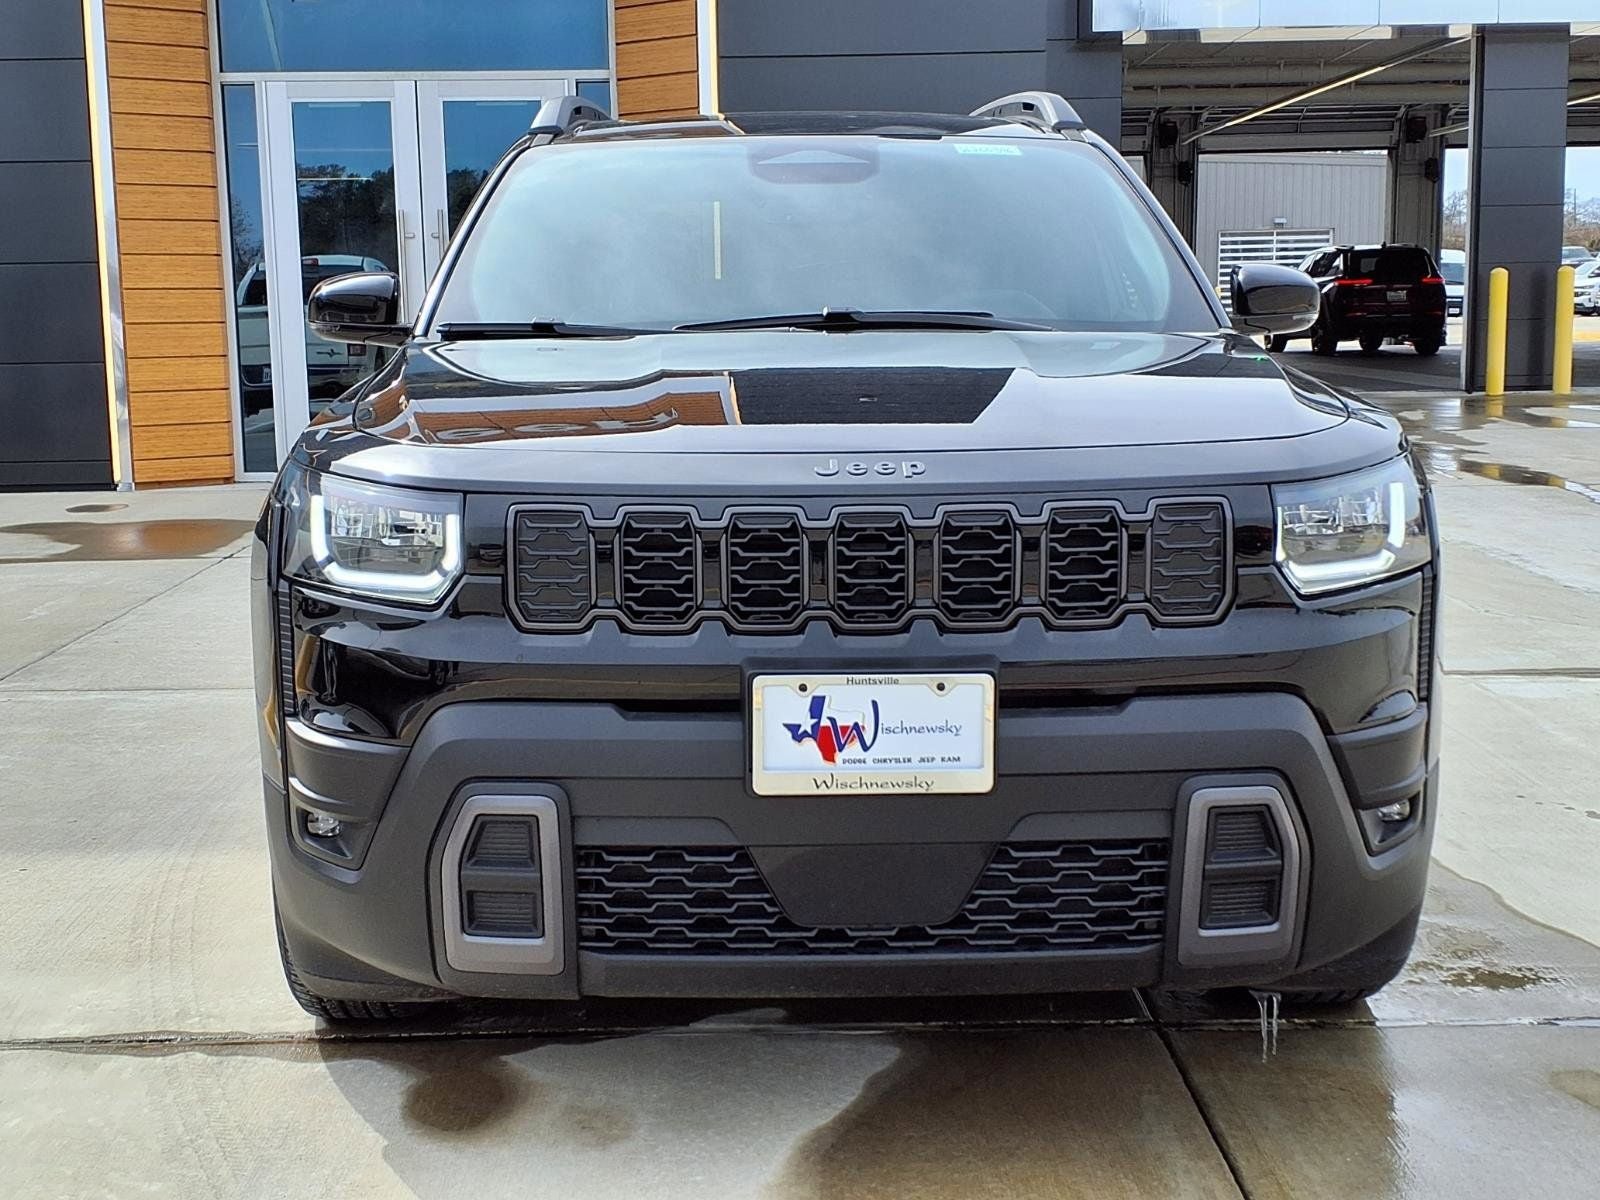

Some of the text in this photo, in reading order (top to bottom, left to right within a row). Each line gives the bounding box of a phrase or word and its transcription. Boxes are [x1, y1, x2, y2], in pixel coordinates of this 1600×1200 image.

[814, 459, 926, 478] Jeep
[846, 676, 899, 686] Huntsville
[827, 699, 962, 753] Wischnewsky
[872, 757, 912, 765] CHRYSLER
[918, 756, 936, 764] JEEP
[940, 756, 961, 764] RAM
[812, 773, 934, 792] Wischnewsky
